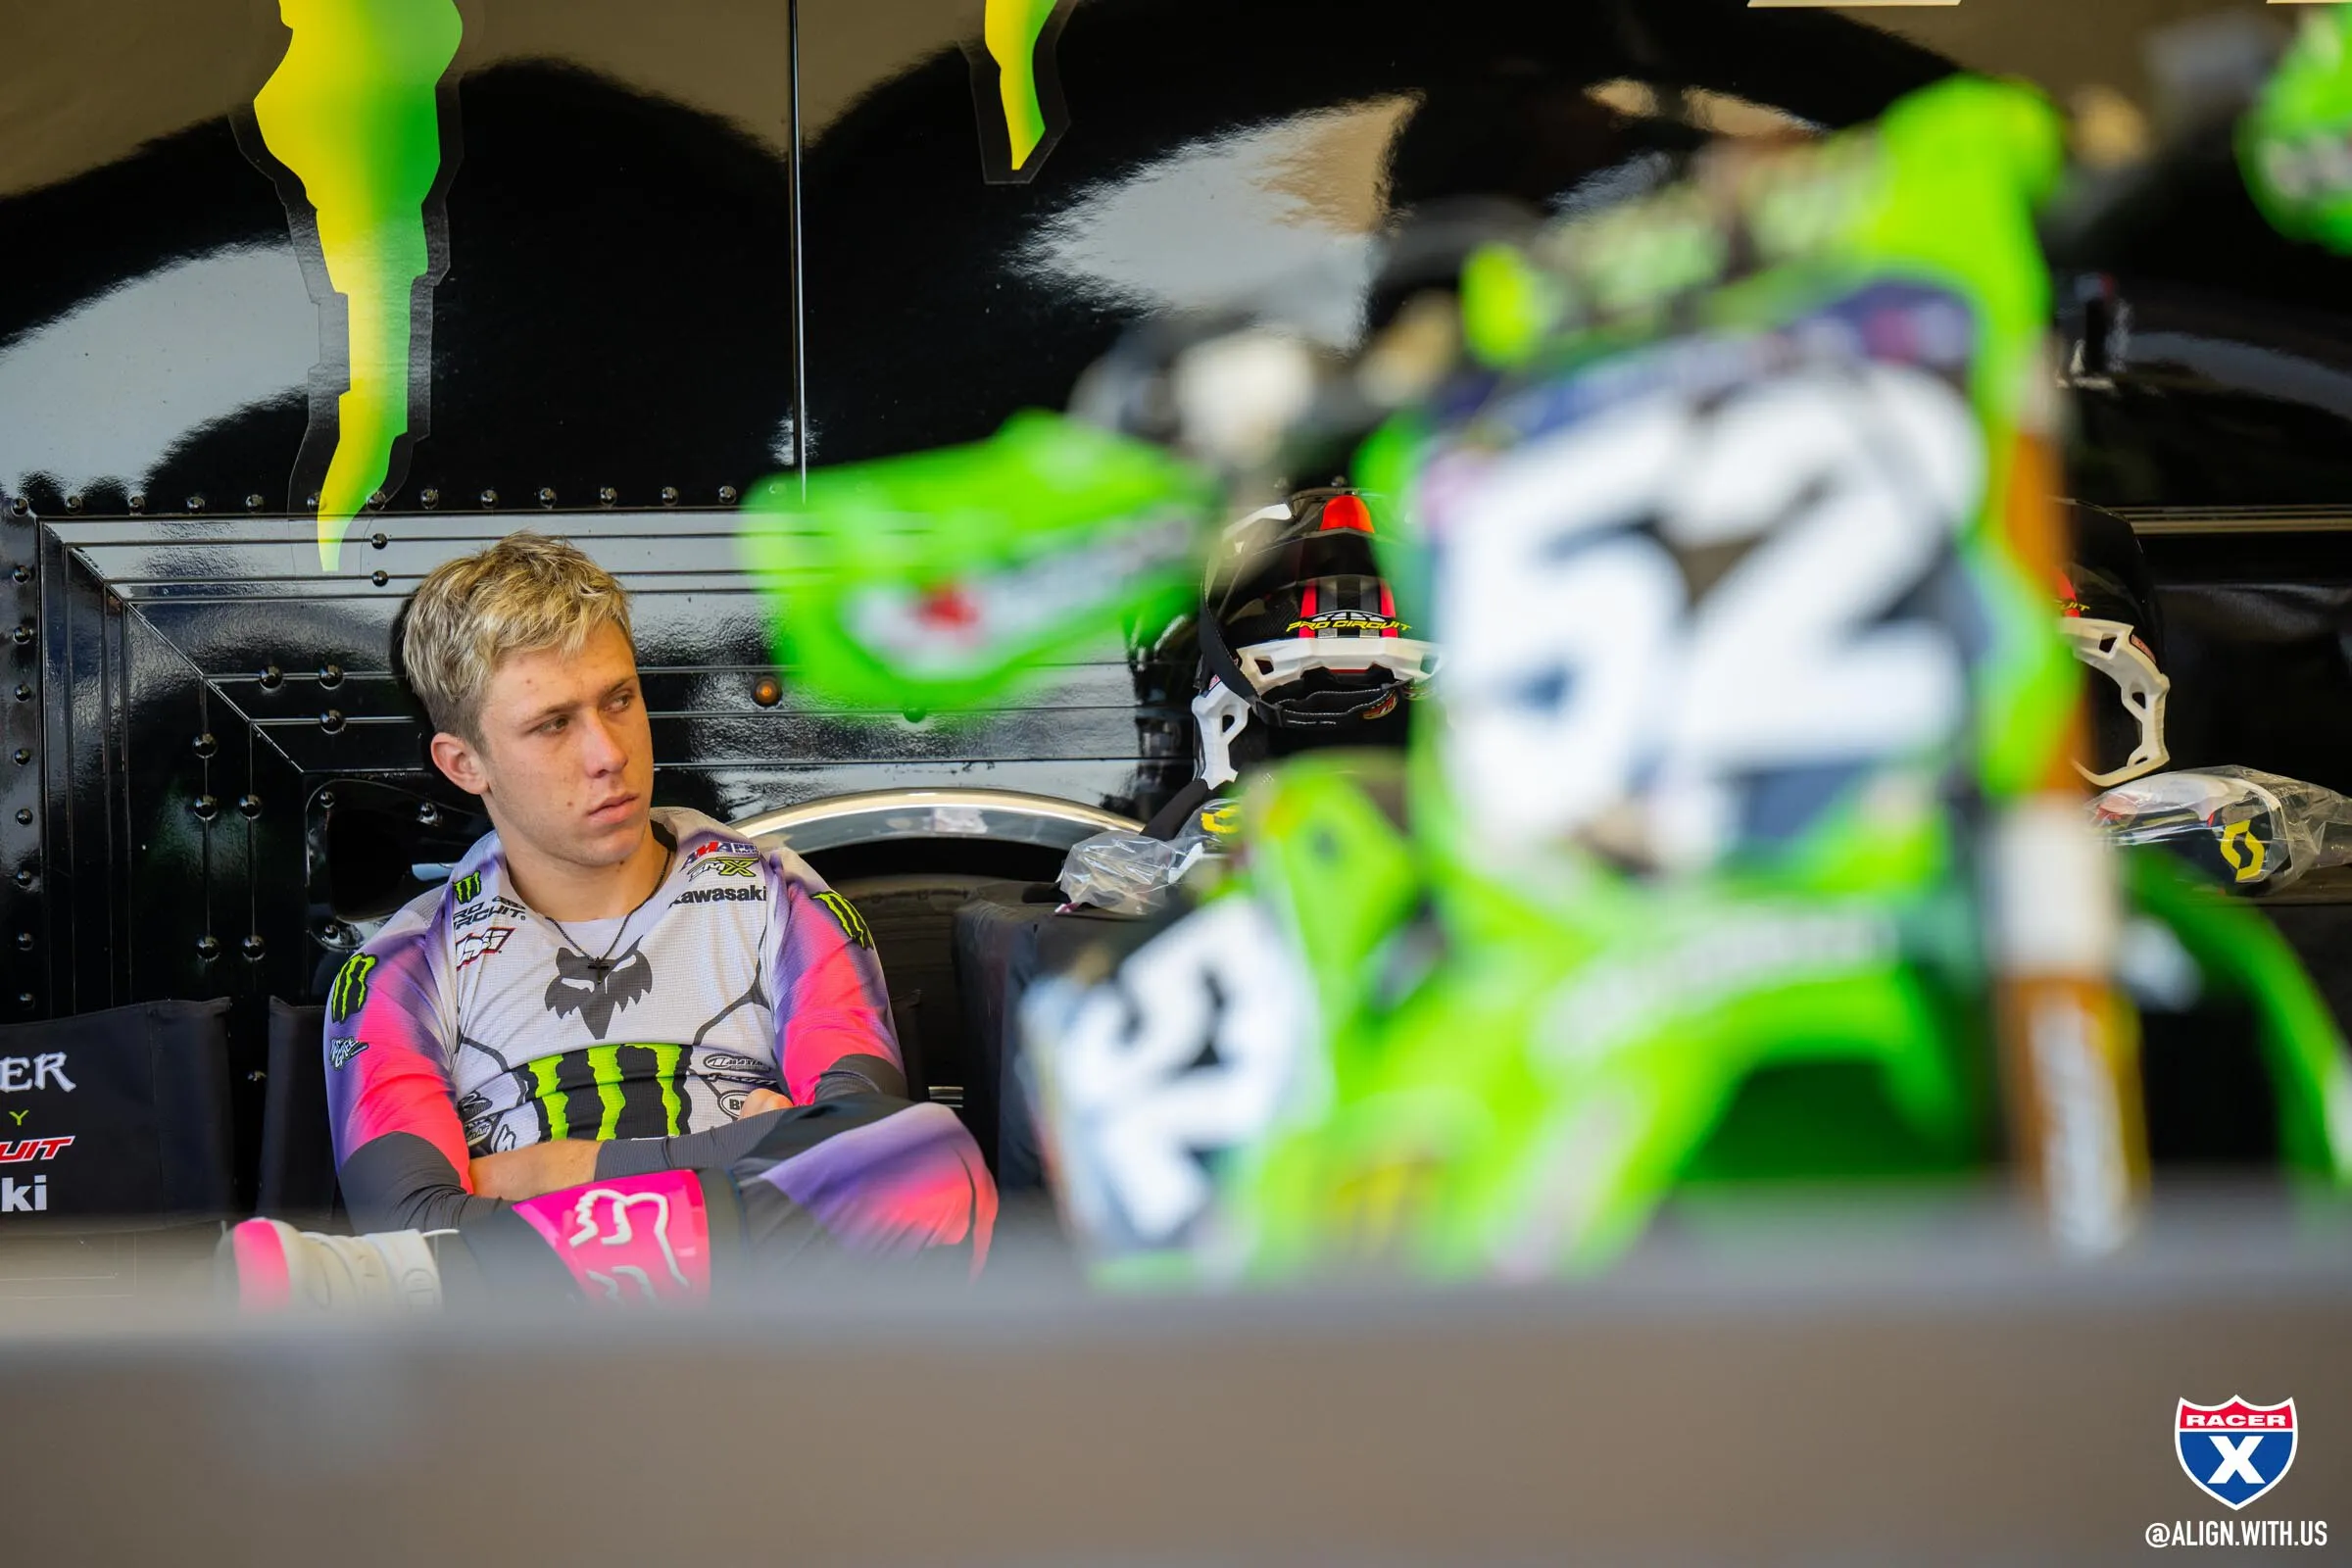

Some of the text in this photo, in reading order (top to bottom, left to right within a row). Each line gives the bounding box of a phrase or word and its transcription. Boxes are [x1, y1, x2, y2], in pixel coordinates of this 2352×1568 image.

[1439, 370, 1985, 833] 52
[1286, 620, 1411, 632] PRO CIRCUIT
[9, 1109, 29, 1126] Y
[1, 1175, 47, 1212] ki
